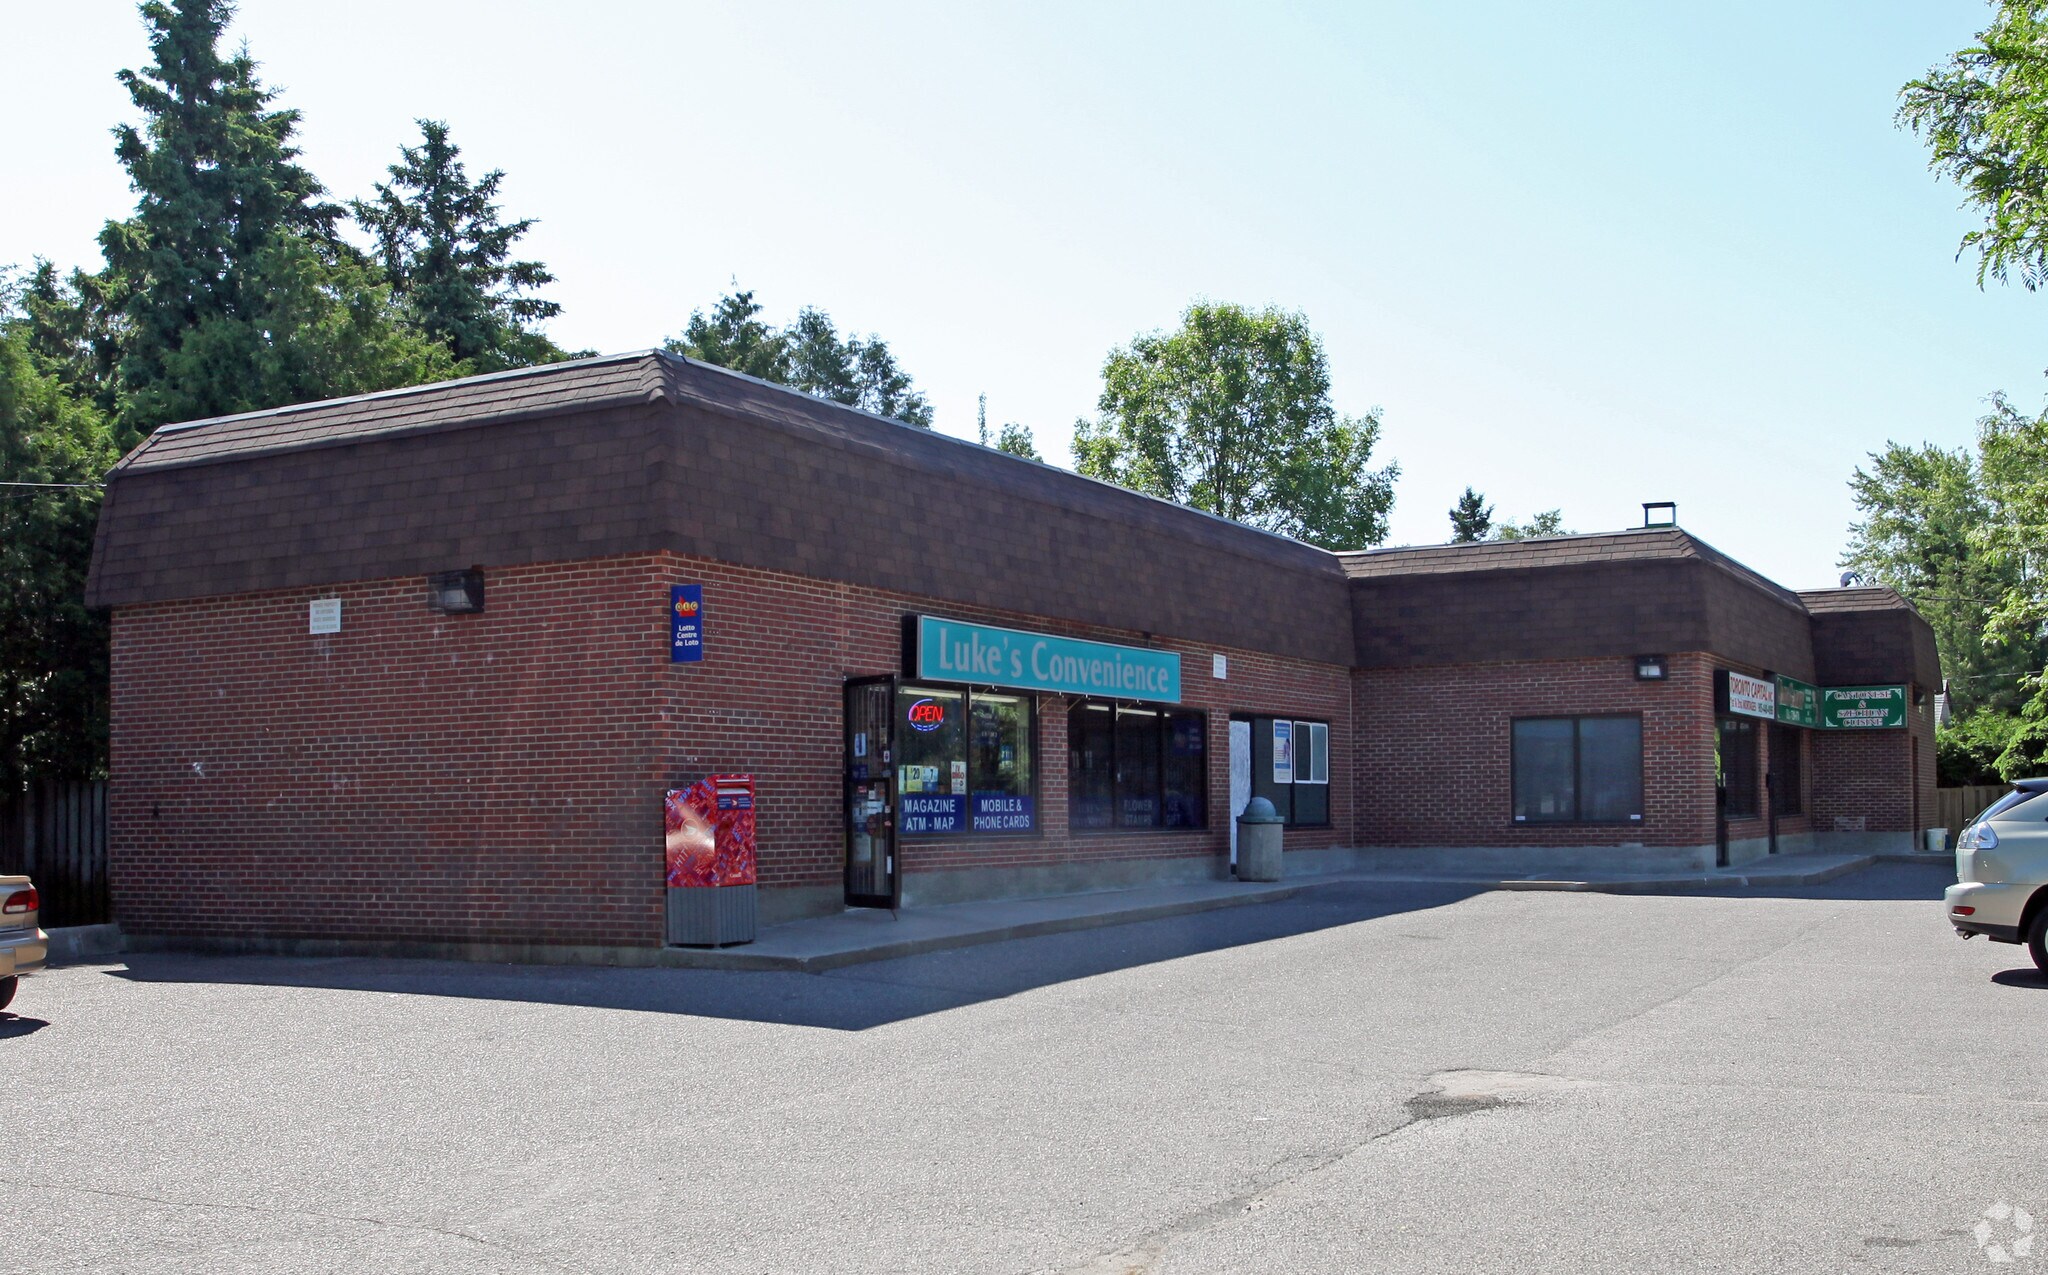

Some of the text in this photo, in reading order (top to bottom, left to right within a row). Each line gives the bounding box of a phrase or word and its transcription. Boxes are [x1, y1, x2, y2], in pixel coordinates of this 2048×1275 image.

[678, 624, 696, 632] Lotto
[676, 631, 698, 639] Centre
[674, 639, 699, 647] de Loto
[939, 627, 1023, 678] Luke's
[1031, 640, 1169, 693] Convenience
[1729, 676, 1750, 697] TORONTO
[1750, 681, 1767, 701] CAPITAL
[1833, 690, 1892, 700] CANTONESE
[1857, 700, 1867, 709] &
[911, 705, 945, 722] OPEN
[1837, 708, 1889, 719] SZECHUAN
[1843, 718, 1883, 727] CUISINE
[904, 799, 956, 813] MAGAZINE
[981, 799, 1022, 812] MOBILE &
[905, 817, 926, 831] ATM
[933, 817, 955, 830] MAP
[974, 815, 1030, 829] PHONE CARDS
